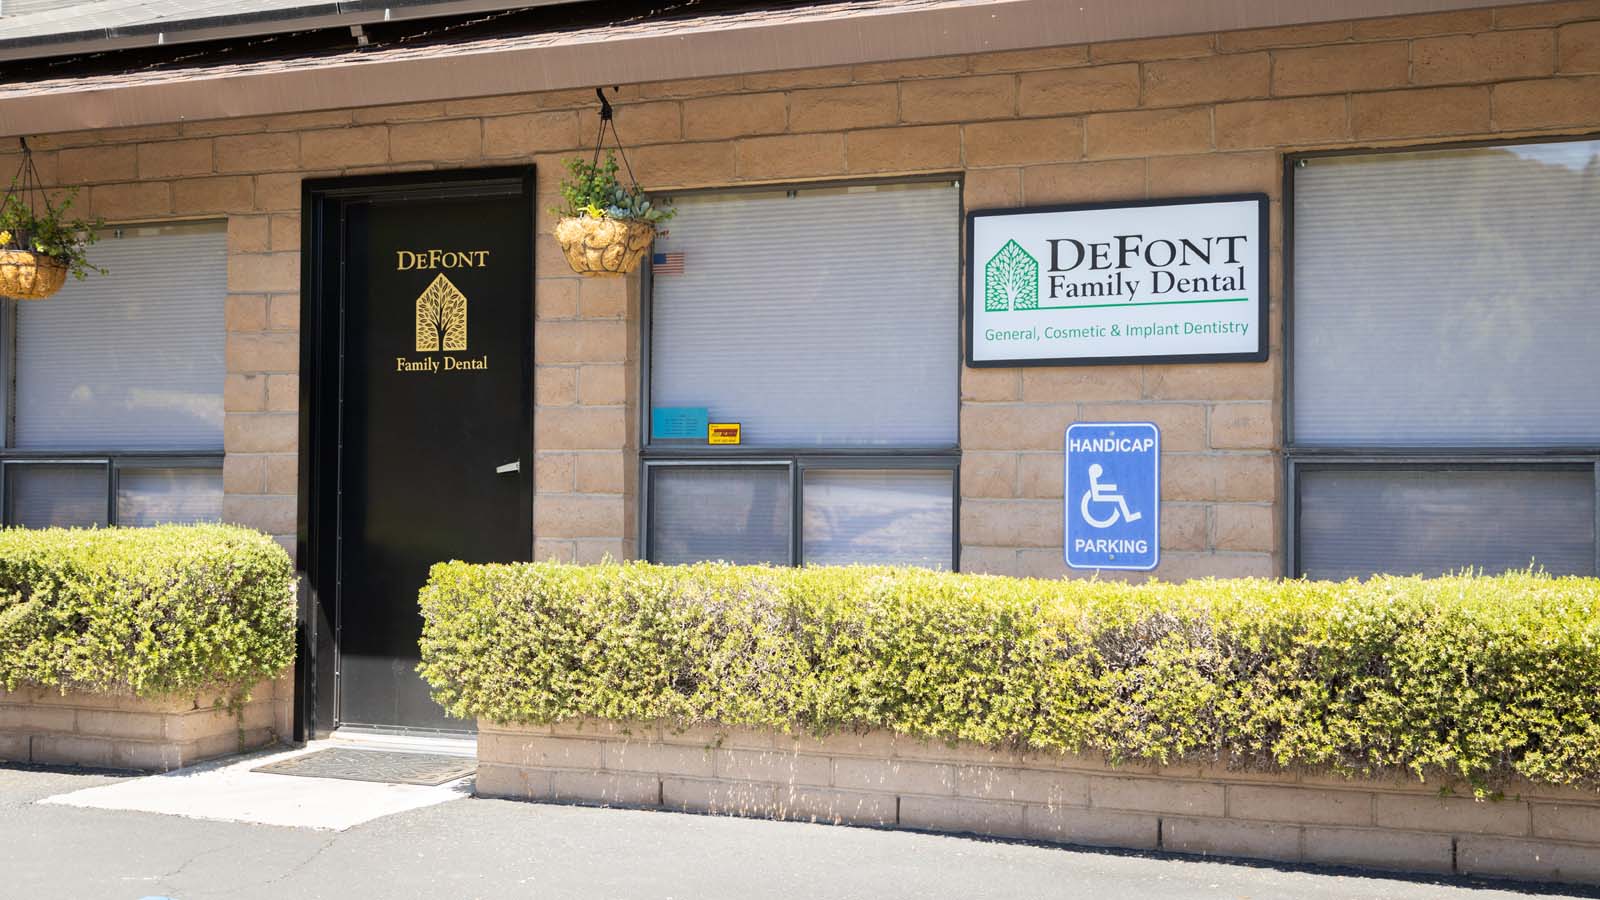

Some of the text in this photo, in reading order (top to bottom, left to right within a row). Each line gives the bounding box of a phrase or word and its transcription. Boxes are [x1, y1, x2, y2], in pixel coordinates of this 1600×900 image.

[1048, 266, 1246, 301] Family Dental
[985, 320, 1249, 341] General, Cosmetic & Implant Dentistry
[396, 355, 488, 374] Family Dental
[1070, 438, 1154, 453] HANDICAP
[1075, 539, 1148, 553] PARKING
